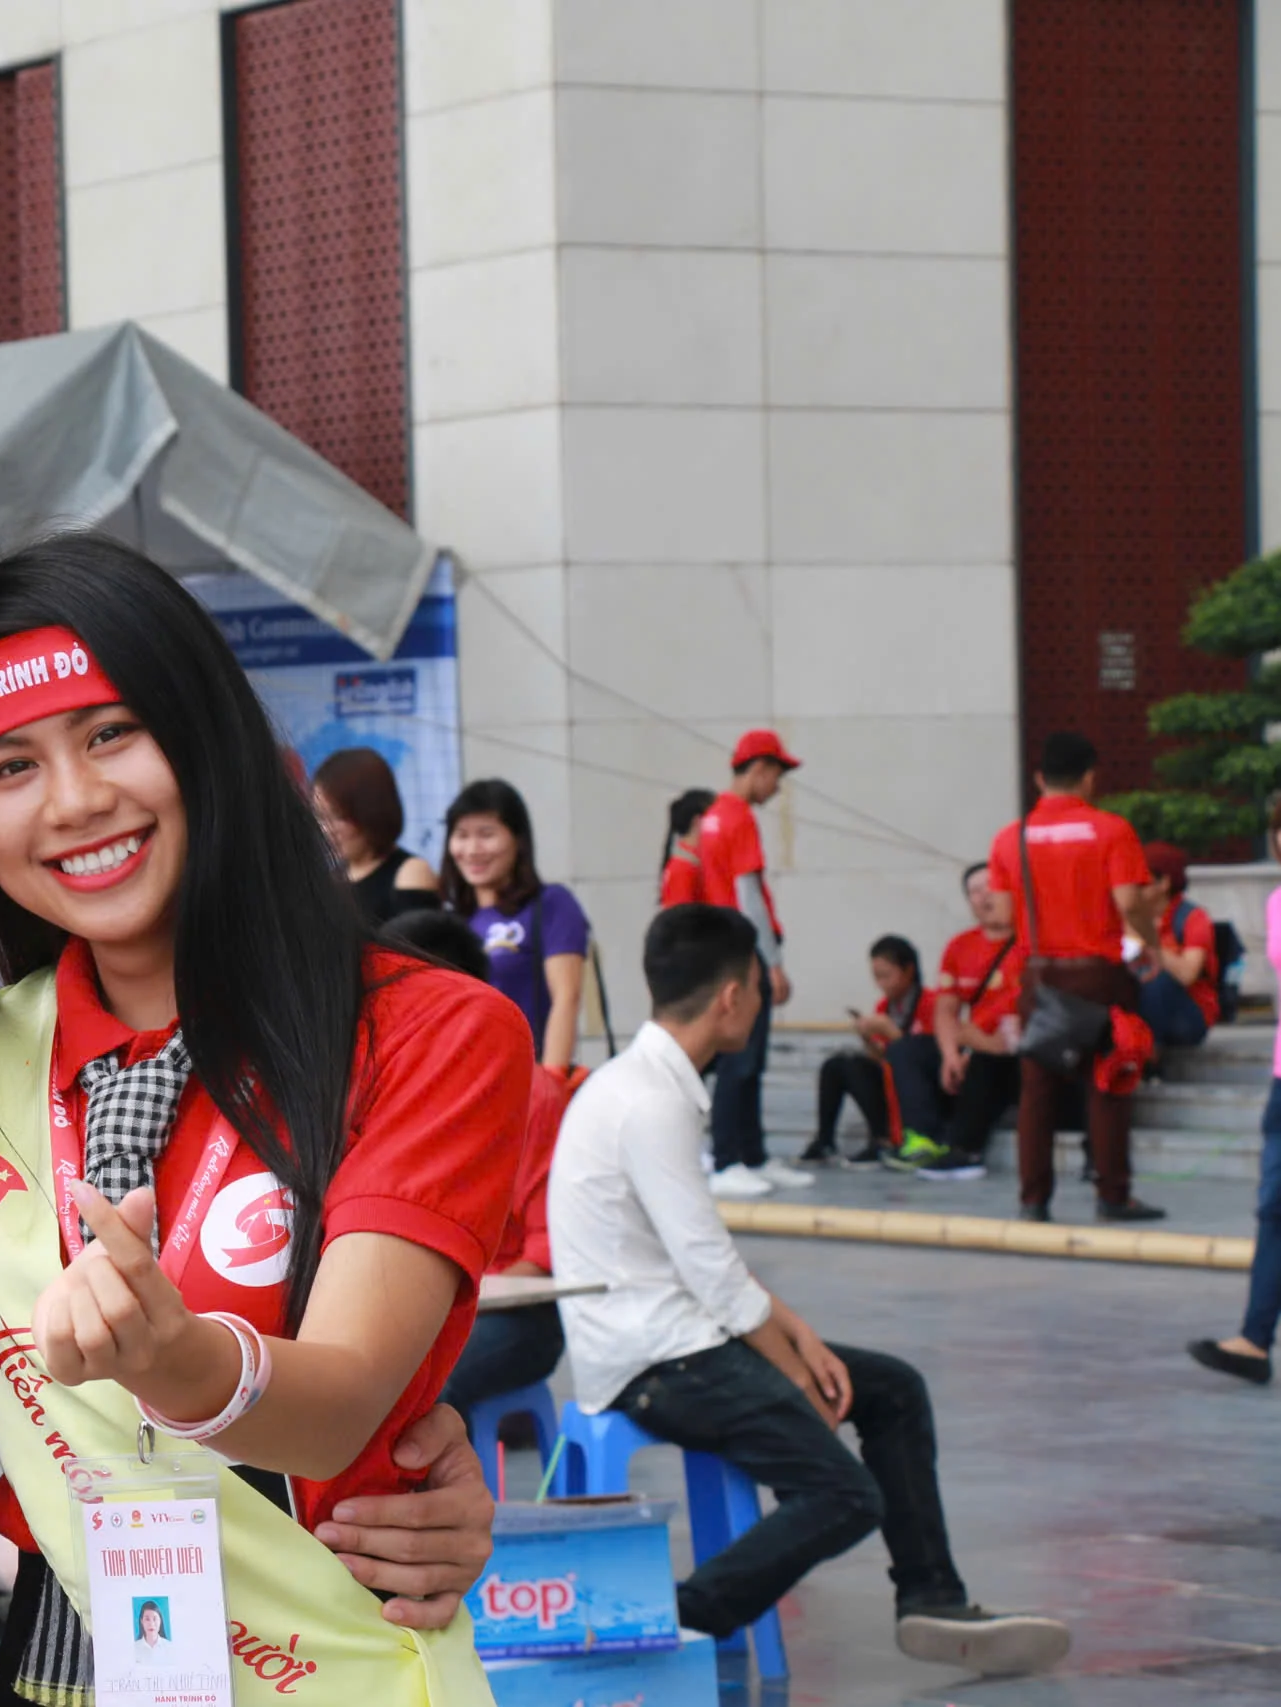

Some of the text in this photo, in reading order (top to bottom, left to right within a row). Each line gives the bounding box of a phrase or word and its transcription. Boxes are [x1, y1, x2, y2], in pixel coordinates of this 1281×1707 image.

[53, 641, 89, 680] ĐỎ
[101, 1547, 126, 1576] TÌNH
[483, 1577, 573, 1629] top
